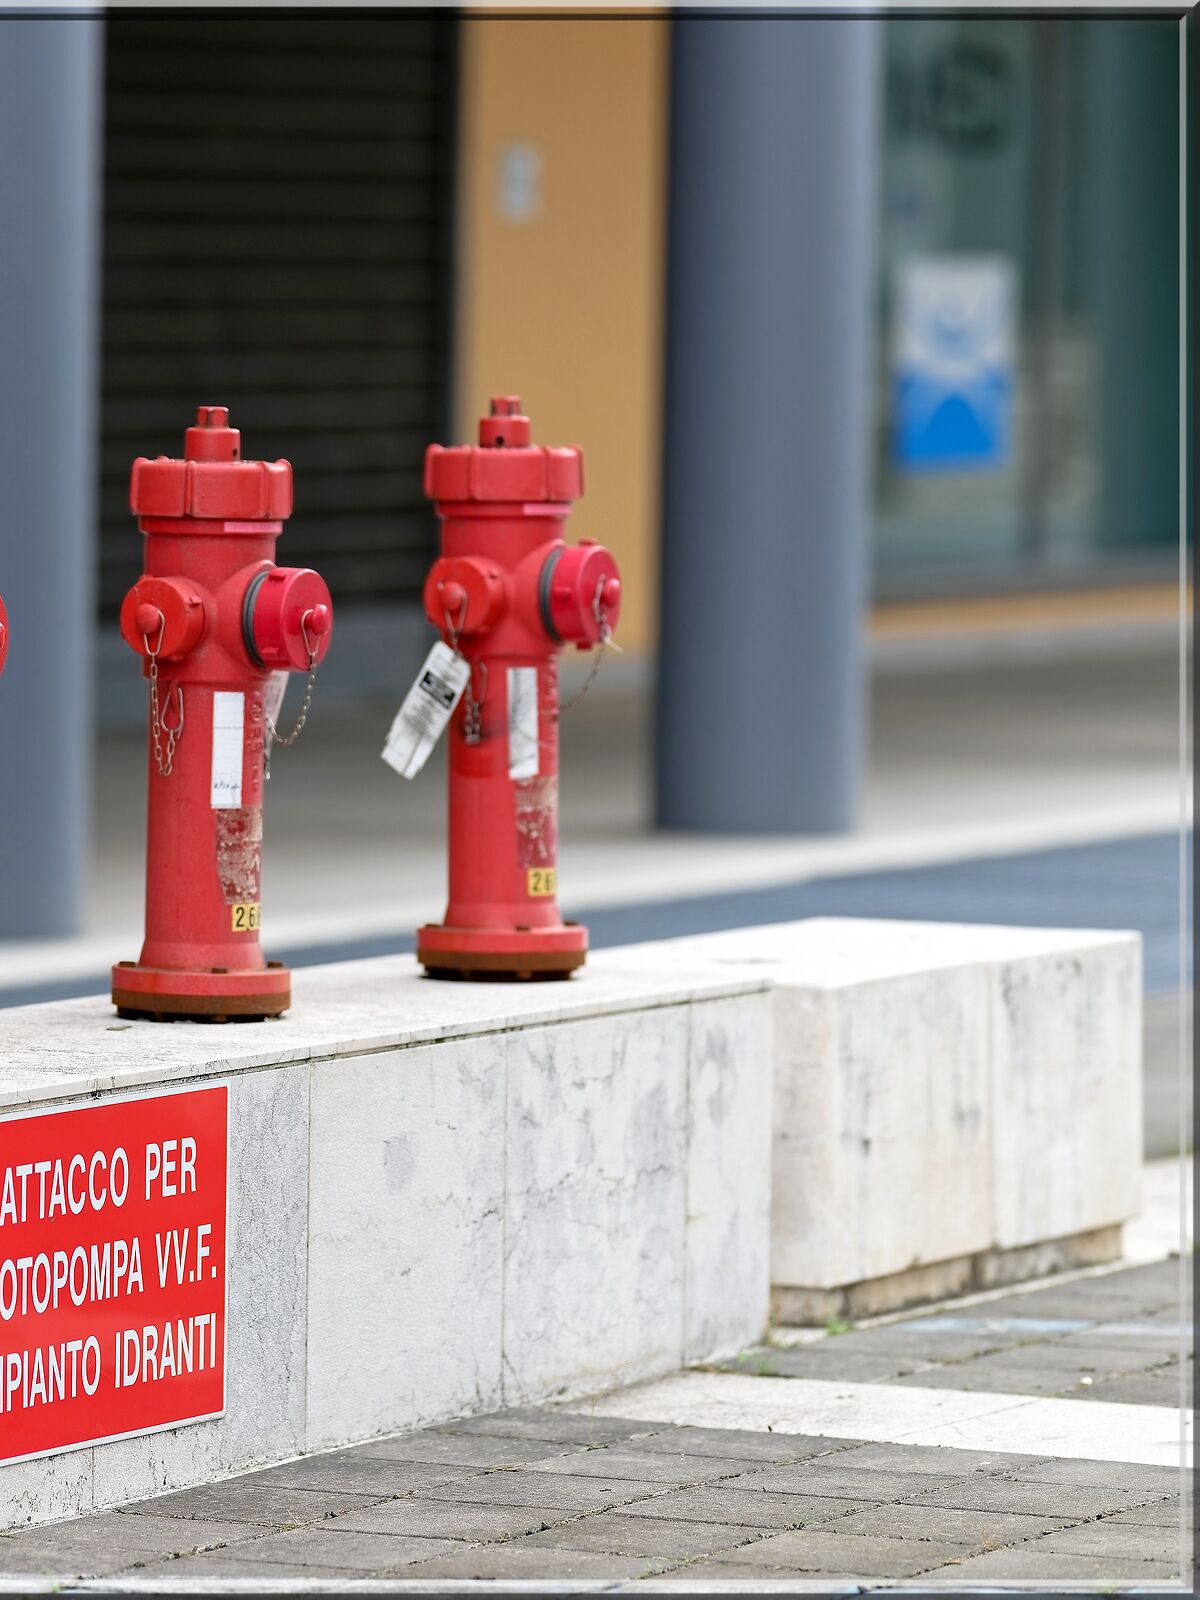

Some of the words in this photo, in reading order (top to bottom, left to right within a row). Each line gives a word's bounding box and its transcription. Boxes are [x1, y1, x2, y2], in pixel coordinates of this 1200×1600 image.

[145, 1136, 197, 1201] PER
[155, 1223, 218, 1289] VV.F.
[115, 1312, 216, 1389] IDRANTI
